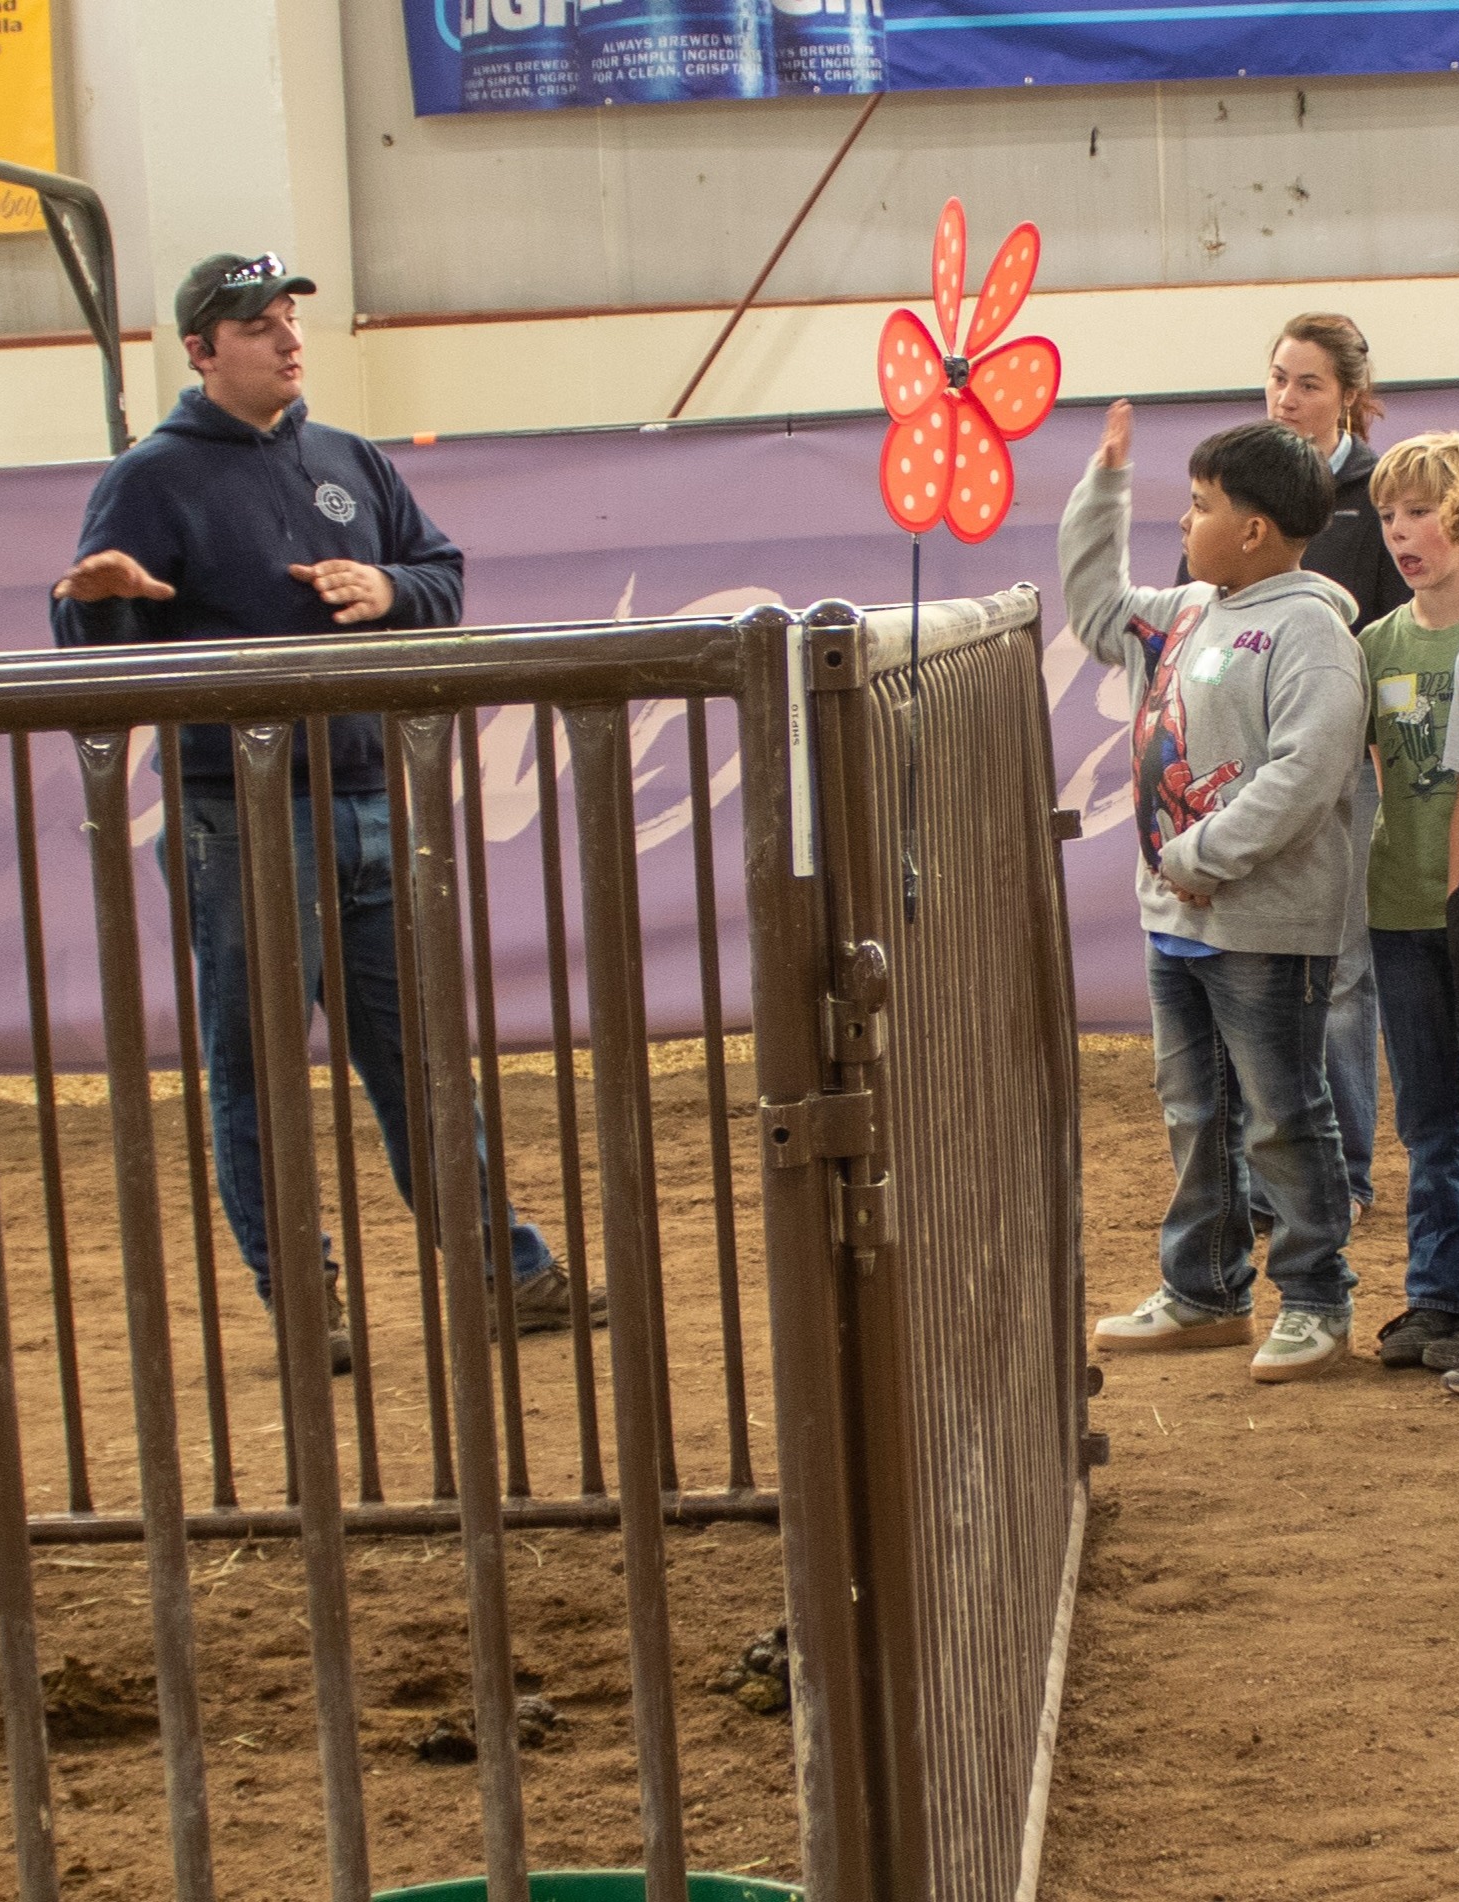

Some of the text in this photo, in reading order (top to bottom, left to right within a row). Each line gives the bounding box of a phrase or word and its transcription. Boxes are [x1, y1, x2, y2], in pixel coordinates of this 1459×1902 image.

[602, 37, 652, 53] ALWAYS
[658, 34, 720, 48] BREWED
[799, 44, 851, 57] BREWED
[515, 60, 569, 72] BREWED
[591, 56, 619, 70] FOUR
[623, 51, 678, 65] SIMPLE
[778, 58, 816, 70] IMPLE
[487, 73, 531, 87] SIMPLE
[592, 69, 613, 84] FOR
[616, 69, 624, 81] A
[628, 65, 680, 81] CLEAN,
[685, 62, 730, 77] CRISP
[784, 71, 822, 83] LEAN,
[824, 69, 859, 81] CRISP
[490, 87, 534, 99] CLEAN,
[537, 84, 577, 96] CRISP
